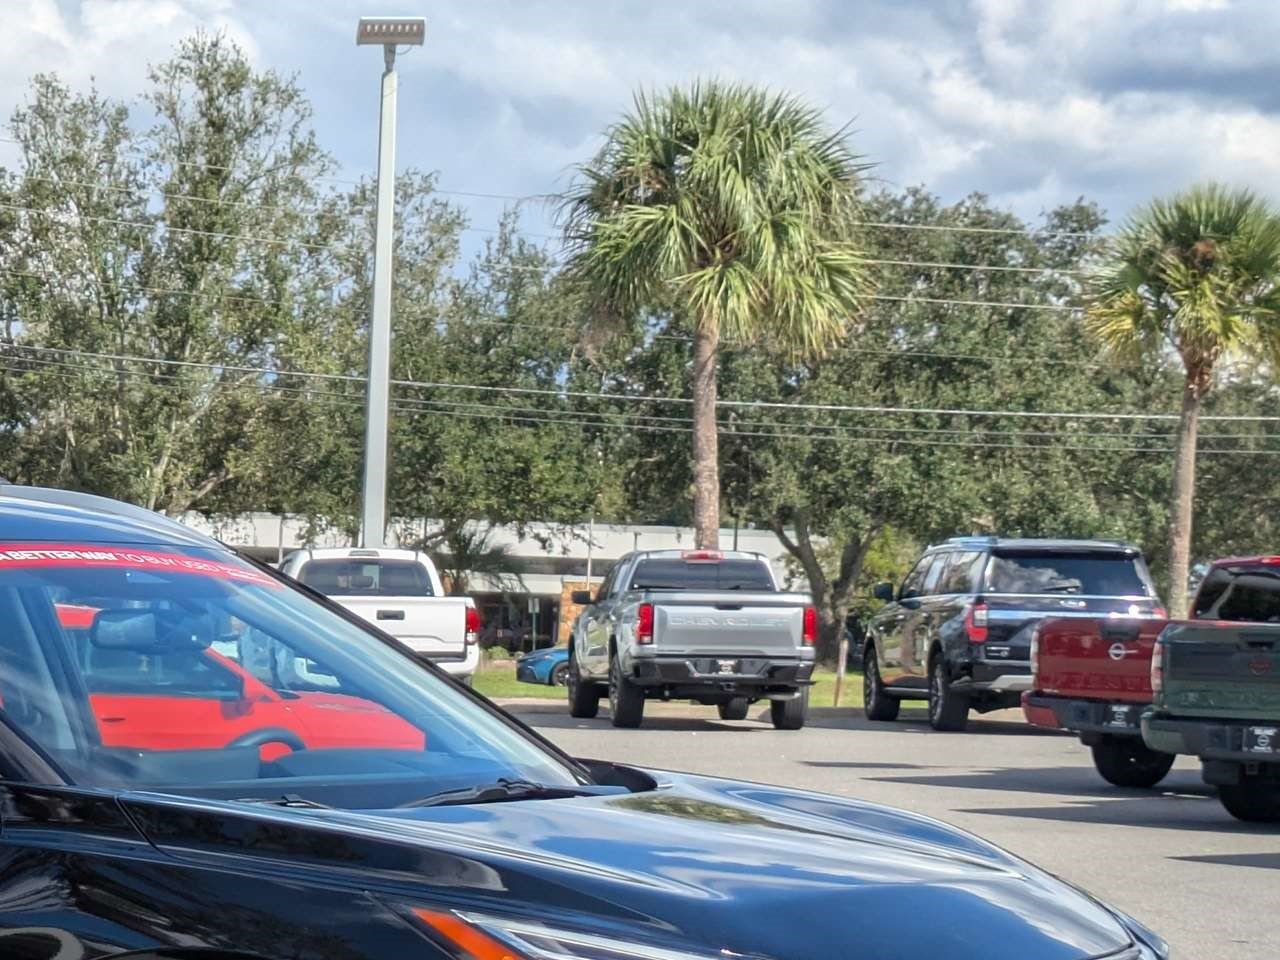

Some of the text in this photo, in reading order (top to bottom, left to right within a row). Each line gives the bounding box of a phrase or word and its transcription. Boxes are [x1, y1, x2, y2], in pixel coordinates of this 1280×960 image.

[9, 551, 79, 560] BETTER
[77, 551, 118, 561] WAY
[116, 553, 144, 563] TO
[141, 555, 177, 566] BUY
